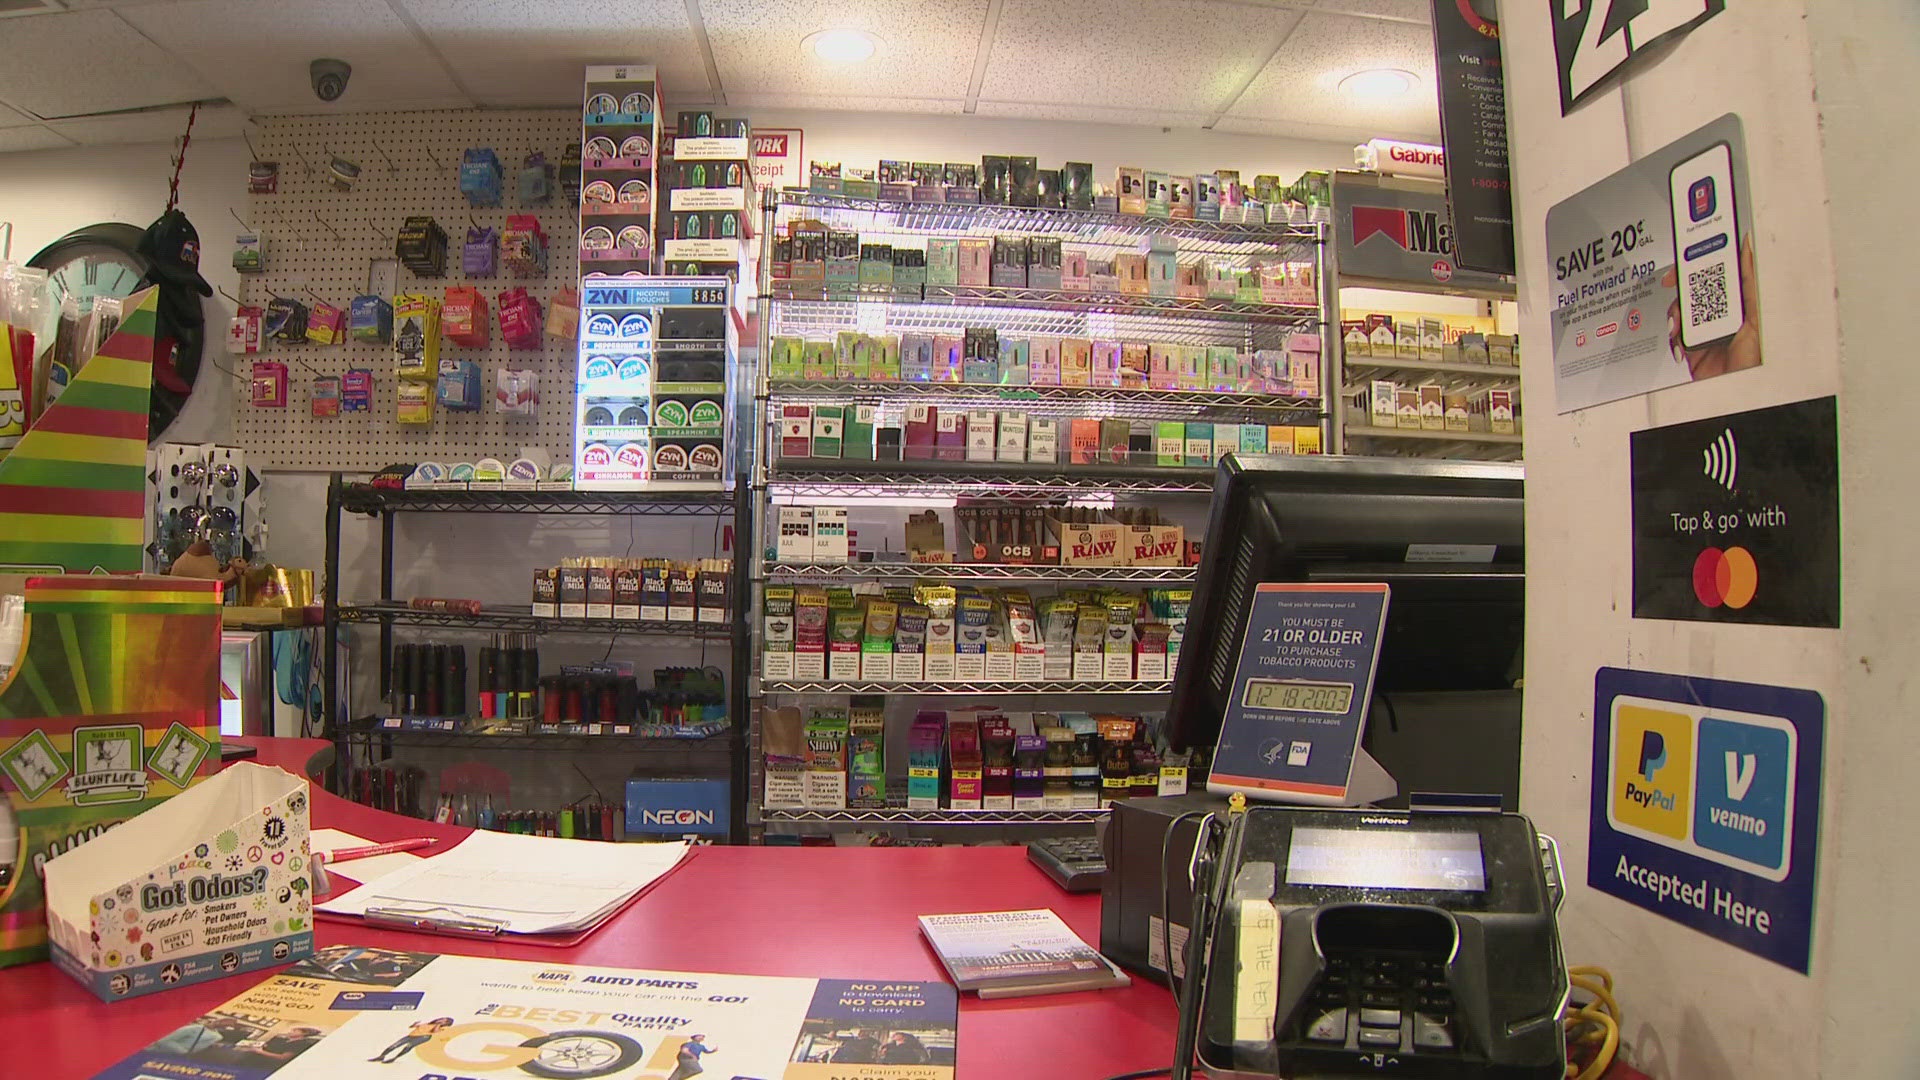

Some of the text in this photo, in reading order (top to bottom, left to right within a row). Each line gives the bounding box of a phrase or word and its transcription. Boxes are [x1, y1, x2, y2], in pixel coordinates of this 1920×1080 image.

[1459, 54, 1480, 65] Visit
[1390, 145, 1444, 166] Gabrie
[752, 164, 784, 183] ceipt
[1408, 210, 1453, 255] Ma
[1557, 239, 1605, 281] SAVE
[1558, 288, 1579, 308] Fuel
[1631, 260, 1655, 279] App
[588, 290, 628, 304] ZYN
[592, 321, 612, 331] ZYN
[624, 322, 644, 332] ZYN
[1597, 325, 1617, 336] conoco
[663, 406, 683, 421] ZYN
[696, 408, 716, 417] ZYN
[587, 452, 606, 461] ZYN
[621, 451, 642, 464] ZYN
[661, 452, 681, 461] ZYN
[695, 451, 717, 462] ZYN
[1671, 506, 1785, 535] Tap & go with
[1002, 545, 1031, 556] OCB
[1072, 541, 1115, 557] RAW
[1134, 541, 1177, 559] RAW
[536, 578, 553, 586] Black
[564, 575, 583, 584] Black
[591, 576, 609, 584] Black
[645, 577, 664, 585] Black
[703, 580, 723, 588] Black
[539, 584, 555, 593] Mild
[568, 582, 584, 590] Mild
[621, 584, 638, 592] Mild
[649, 584, 666, 592] Mild
[675, 585, 693, 593] Mild
[707, 586, 724, 594] Mild
[1283, 618, 1344, 627] YOU MUST BE
[1263, 629, 1363, 644] 21 OR OLDER
[1277, 646, 1342, 656] TO PURCHASE
[1259, 656, 1356, 669] TOBACCO PRODUCTS
[809, 741, 839, 751] SHOW
[1292, 746, 1307, 754] FDA
[1625, 784, 1675, 811] PayPal
[643, 810, 713, 824] NEON
[1361, 817, 1408, 825] Verifone
[1710, 807, 1766, 837] venmo
[169, 858, 212, 878] peace
[141, 867, 269, 913] Got Odors?
[1615, 854, 1770, 934] Accepted Here
[205, 902, 237, 914] Smokers
[146, 912, 178, 933] Great
[205, 911, 248, 925] Pet Owners
[205, 917, 267, 936] Household Odors
[207, 930, 252, 946] 420 Friendly
[272, 978, 326, 990] SAVE
[538, 971, 698, 989] NAPA AUTO PARTS
[480, 981, 517, 989] wants
[707, 995, 748, 1004] GO!
[882, 984, 920, 992] APP
[243, 998, 281, 1007] NAPA
[872, 999, 925, 1007] CARD
[492, 1005, 611, 1026] BEST
[611, 1012, 692, 1025] Quality
[622, 1022, 675, 1030] PARTS
[142, 1061, 201, 1075] SAVING
[860, 1068, 900, 1076] Claim
